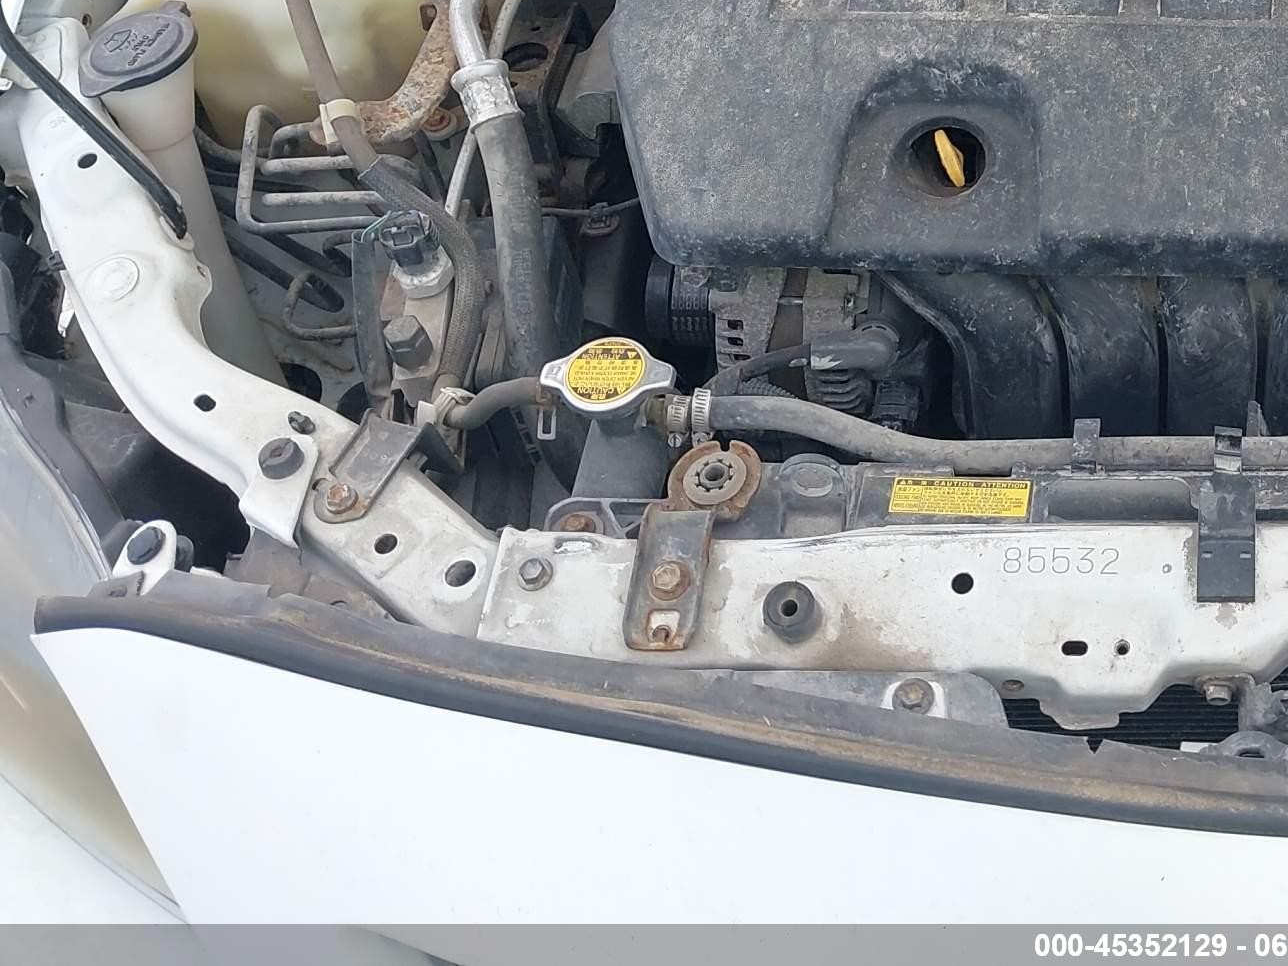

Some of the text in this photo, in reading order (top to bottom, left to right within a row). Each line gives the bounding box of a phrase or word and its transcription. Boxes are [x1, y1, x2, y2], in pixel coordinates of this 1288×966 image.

[577, 386, 615, 395] CAUTION
[981, 481, 1026, 489] ATTENTION
[1003, 546, 1121, 575] 85532
